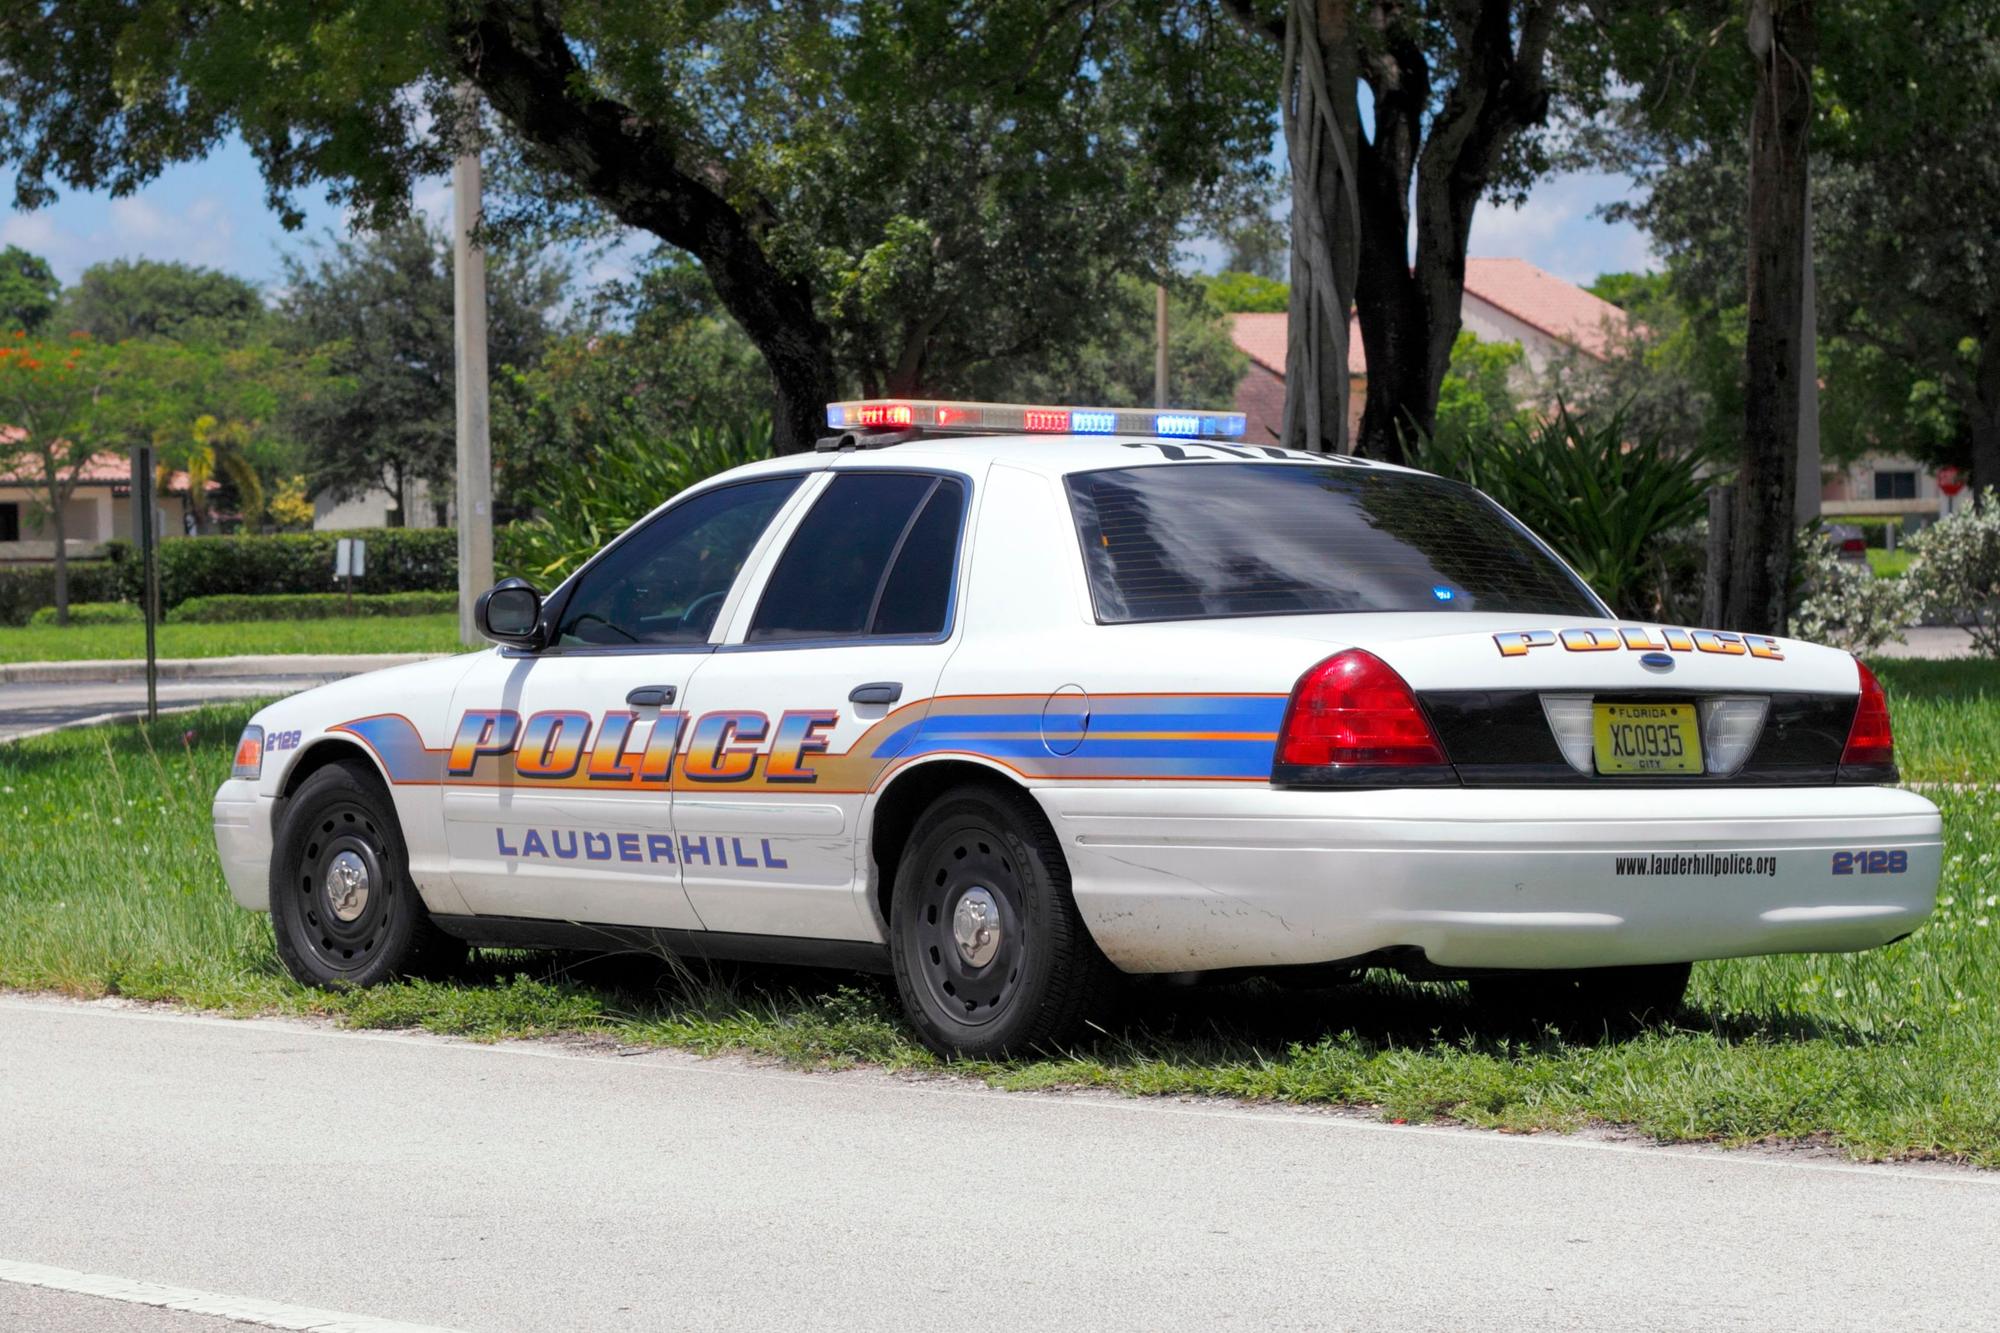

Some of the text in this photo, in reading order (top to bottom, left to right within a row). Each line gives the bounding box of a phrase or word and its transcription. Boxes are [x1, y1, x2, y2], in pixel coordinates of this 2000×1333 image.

[1492, 627, 1785, 661] POLICE
[1618, 708, 1667, 719] FLORIDA
[265, 730, 302, 752] 2128
[448, 709, 840, 784] POLICE
[1610, 724, 1684, 757] XC0935
[1639, 759, 1661, 769] CITY
[496, 827, 788, 869] LAUDERHILL
[1615, 853, 1776, 877] www.lauderhillpolice.org
[1832, 850, 1908, 875] 2128
